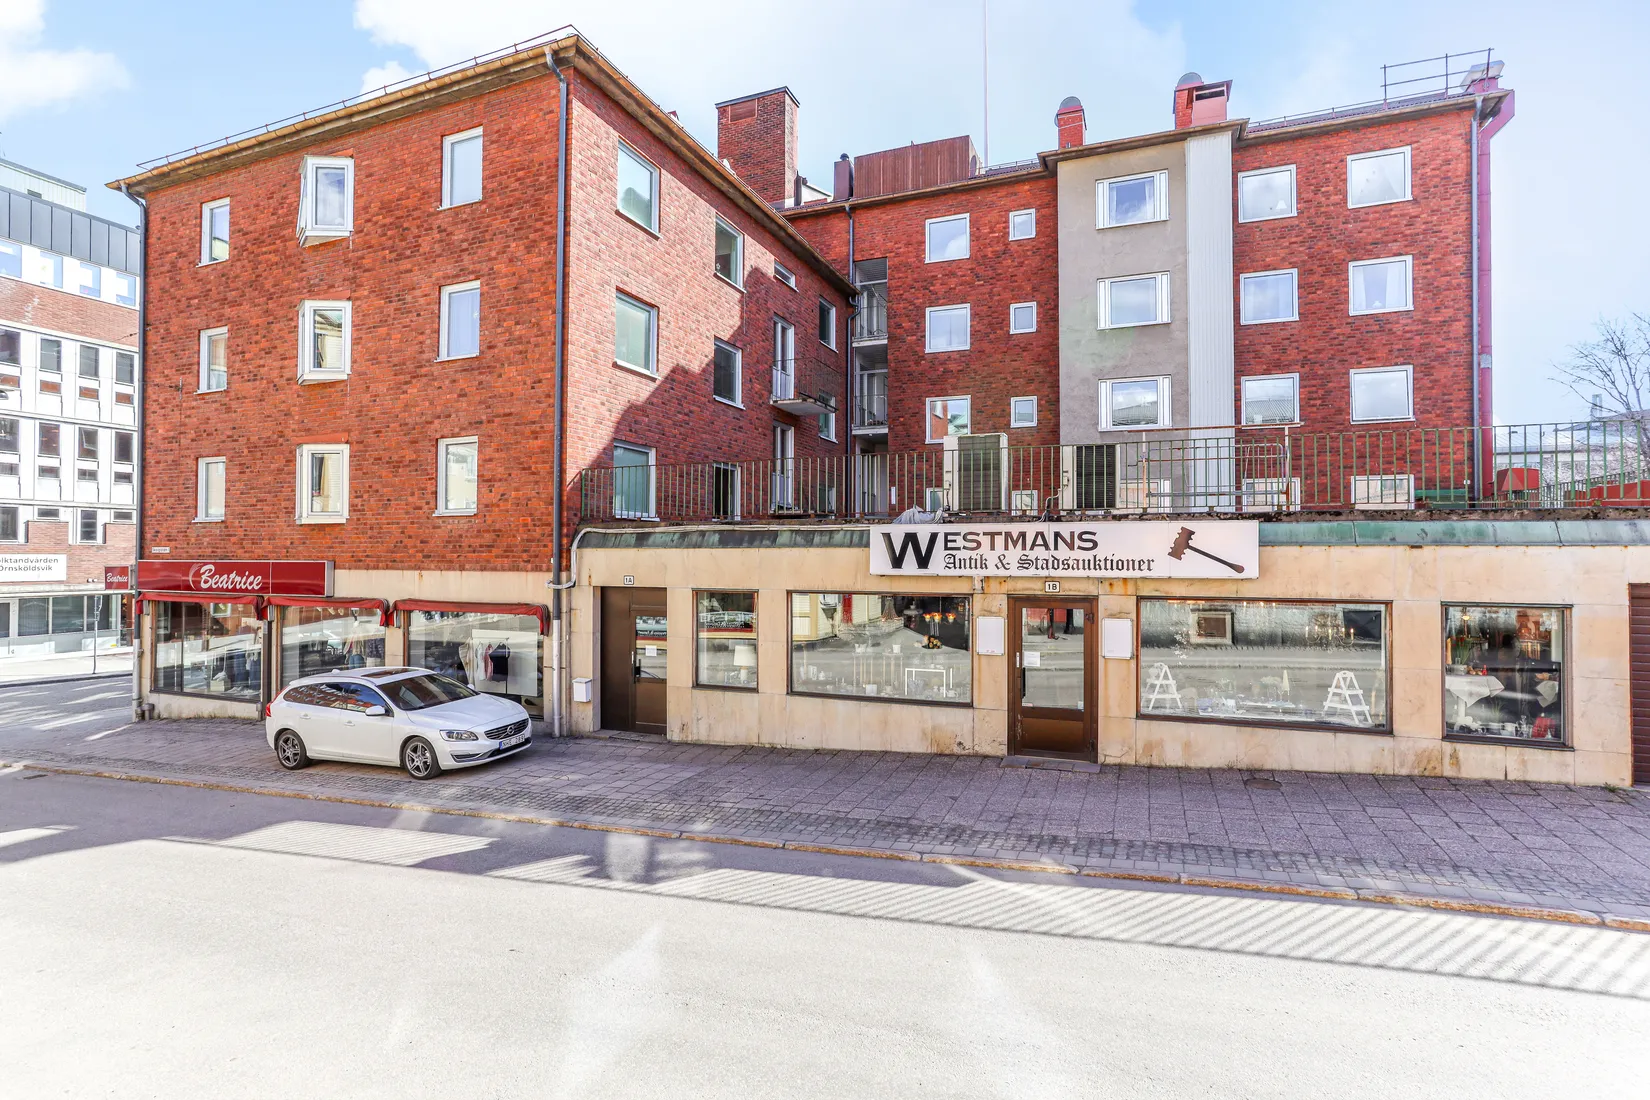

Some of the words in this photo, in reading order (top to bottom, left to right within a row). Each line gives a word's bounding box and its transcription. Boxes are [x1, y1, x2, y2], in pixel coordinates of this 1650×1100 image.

[881, 530, 1098, 570] WESTMANS
[0, 556, 59, 564] lktandvården
[943, 553, 988, 571] Antik
[995, 554, 1011, 571] &
[1017, 553, 1156, 572] Stadsauktioner
[106, 572, 128, 583] Beatrice
[200, 564, 263, 590] Beatrice
